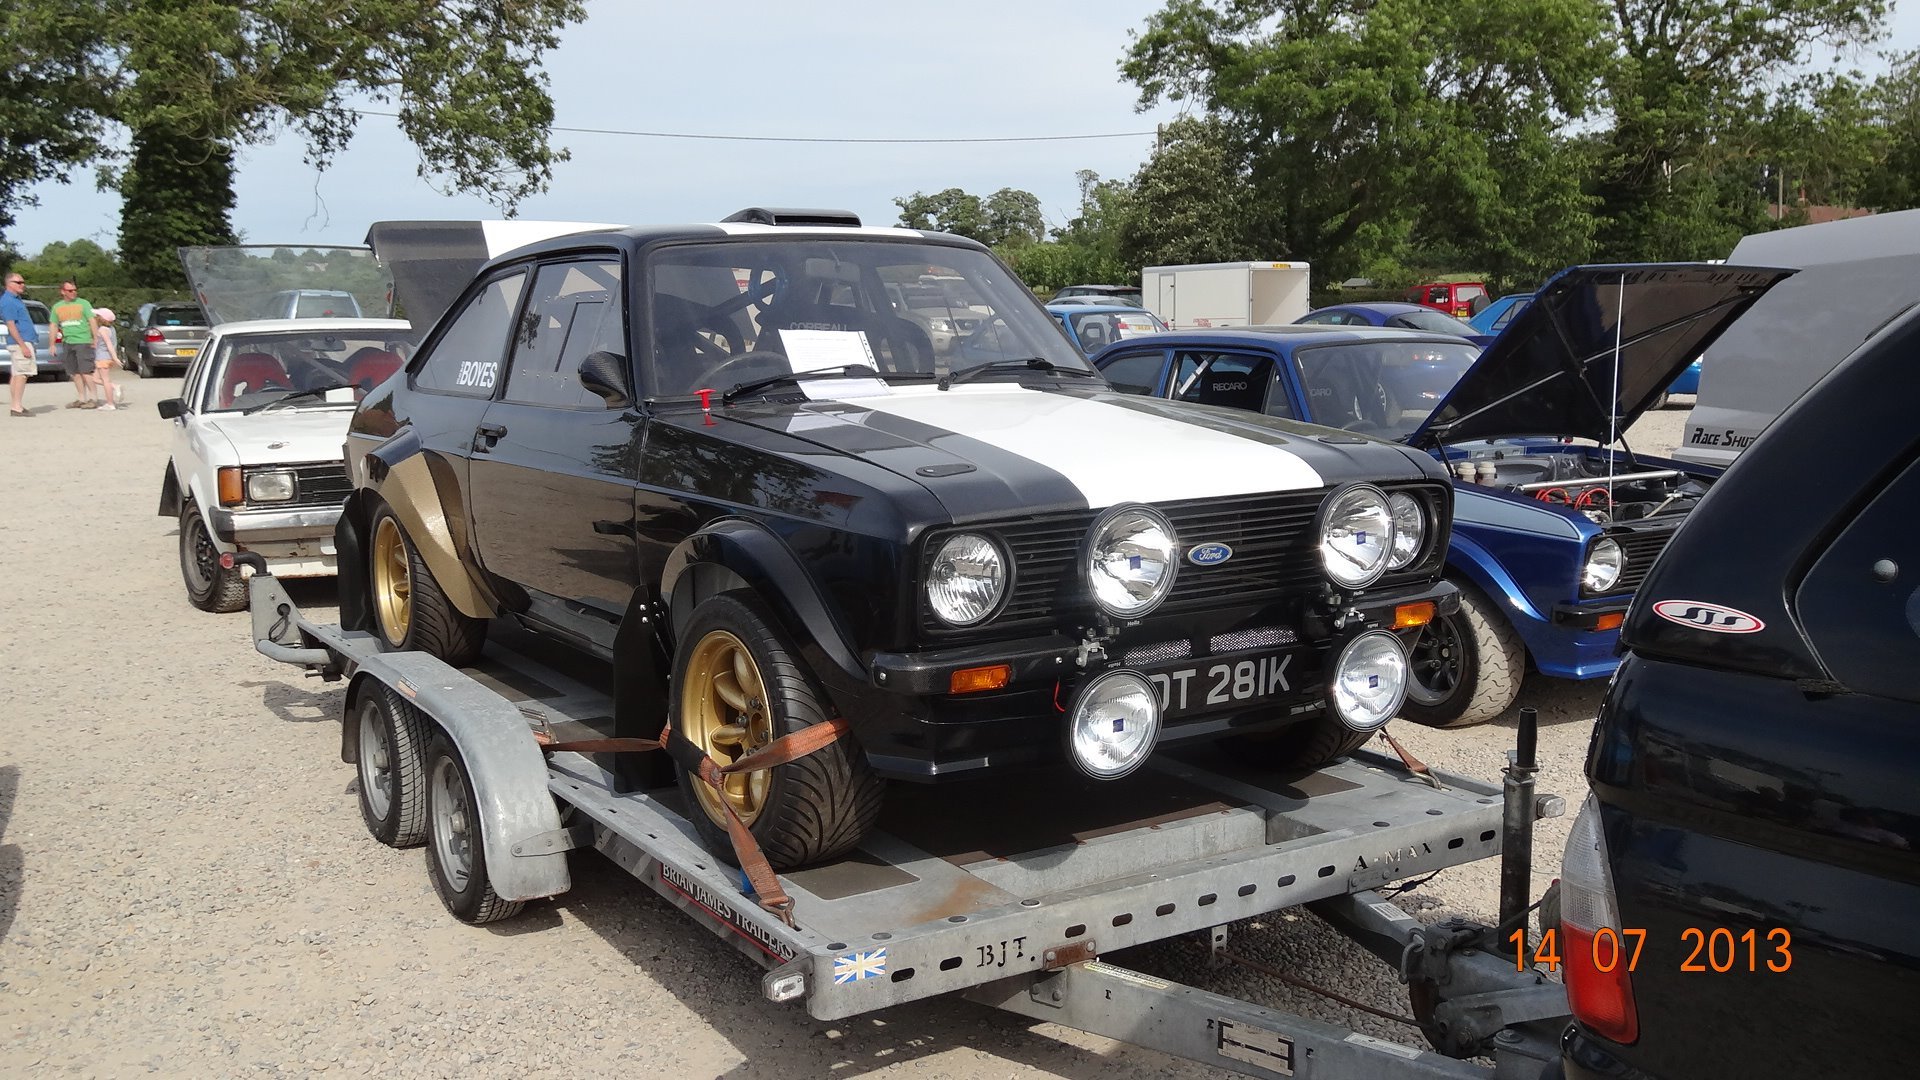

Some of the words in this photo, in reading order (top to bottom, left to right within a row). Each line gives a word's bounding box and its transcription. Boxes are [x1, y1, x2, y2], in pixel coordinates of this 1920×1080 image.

[459, 361, 498, 388] BOYES
[1212, 381, 1248, 392] RECARO
[1199, 547, 1222, 561] Ford
[1206, 654, 1292, 705] 281K
[663, 863, 694, 895] BRIAN
[695, 886, 731, 919] JAMES
[736, 912, 793, 960] TRAILERS
